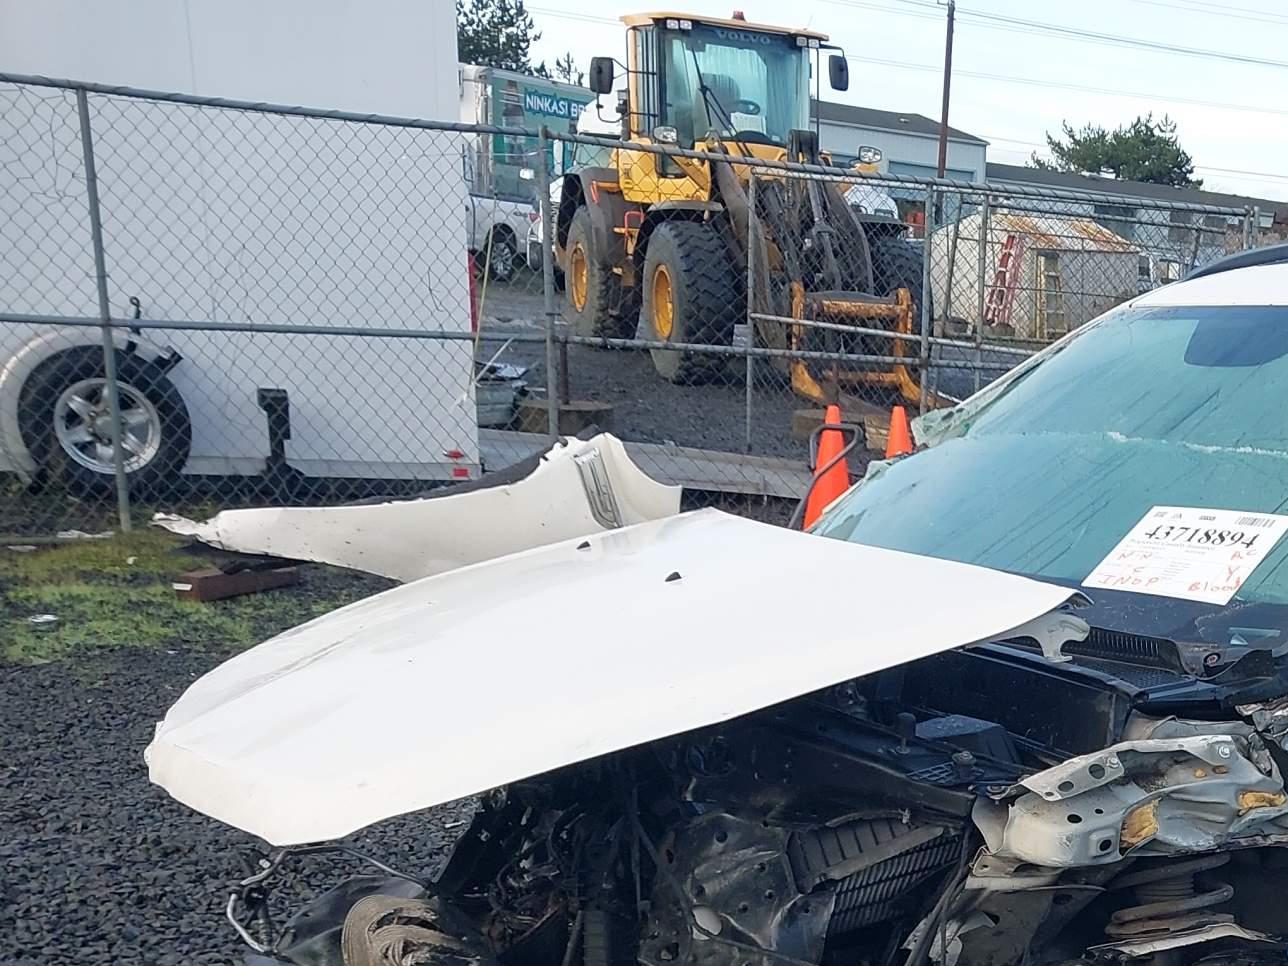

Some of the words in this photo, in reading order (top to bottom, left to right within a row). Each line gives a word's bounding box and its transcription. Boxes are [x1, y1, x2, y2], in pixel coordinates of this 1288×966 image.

[715, 29, 770, 44] VOLVO
[526, 94, 568, 115] NINKASI
[1144, 524, 1260, 549] 43718894
